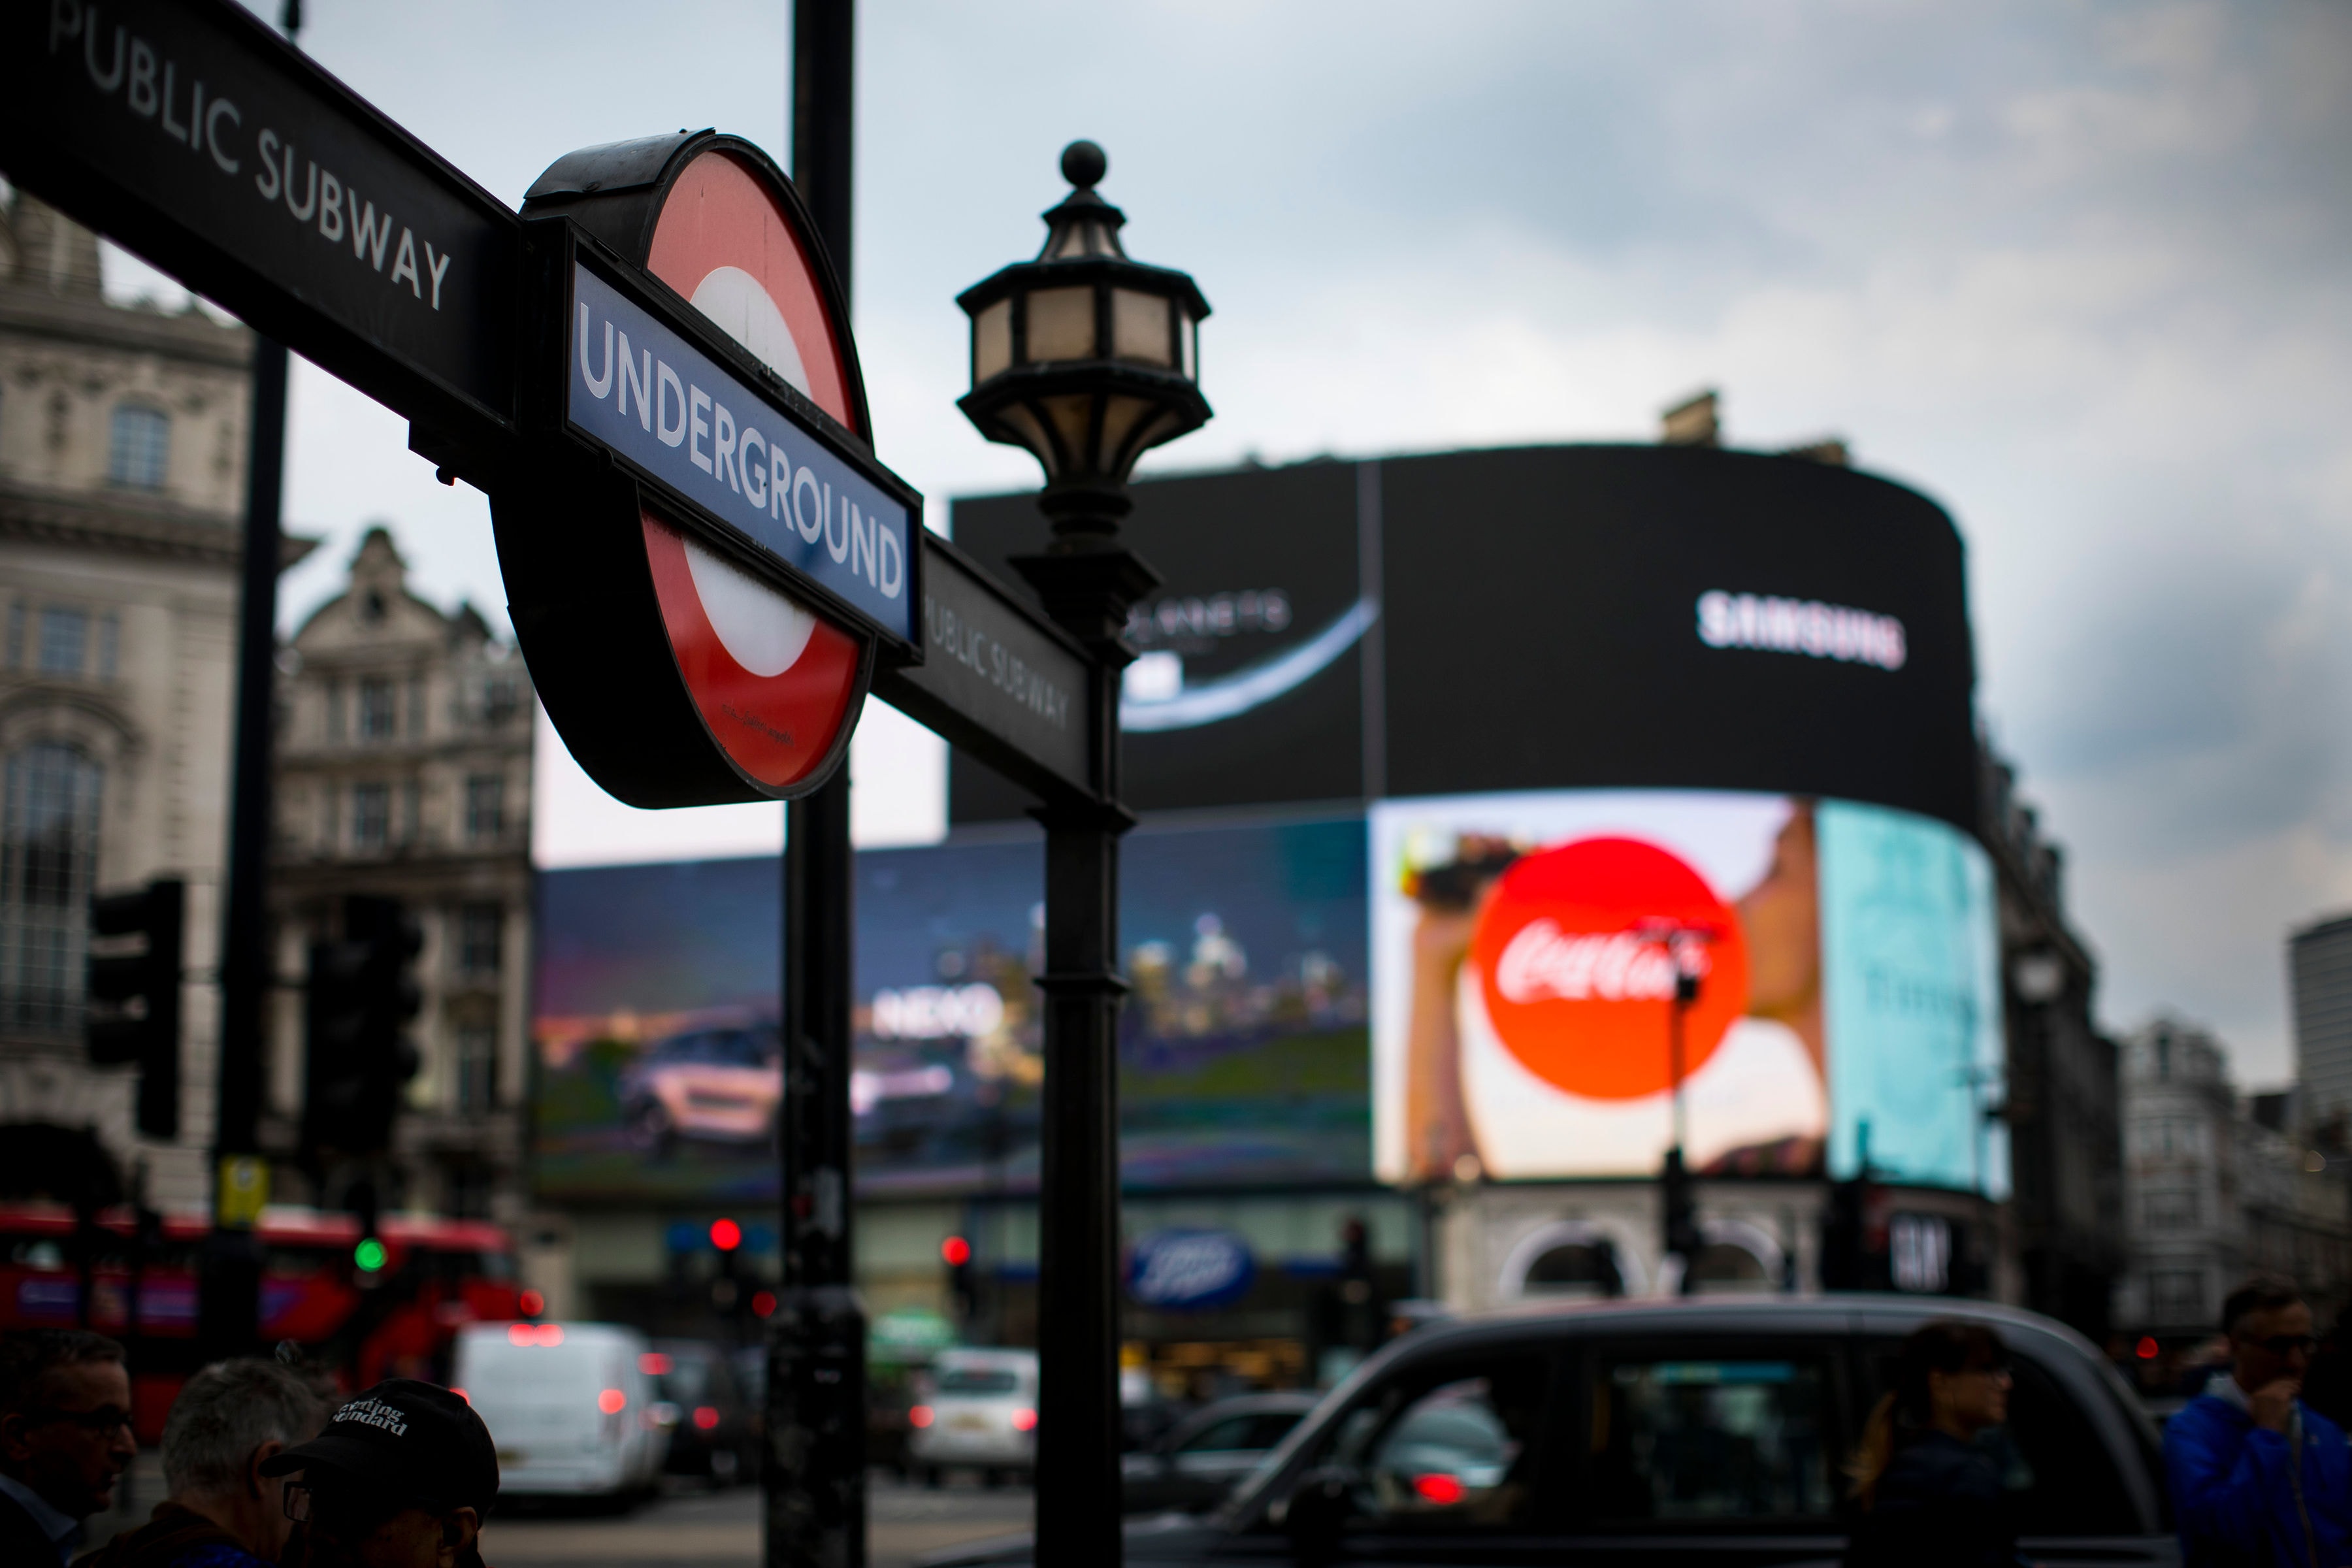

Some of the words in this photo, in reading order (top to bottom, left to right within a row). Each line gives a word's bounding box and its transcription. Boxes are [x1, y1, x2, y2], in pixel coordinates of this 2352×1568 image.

[49, 0, 242, 174] PUBLIC
[255, 129, 451, 312] SUBWAY
[580, 301, 904, 600] UNDERGROUND
[925, 594, 987, 677] UBLIC
[990, 642, 1069, 730] SUBWAY
[1696, 589, 1906, 670] SAMSUNG
